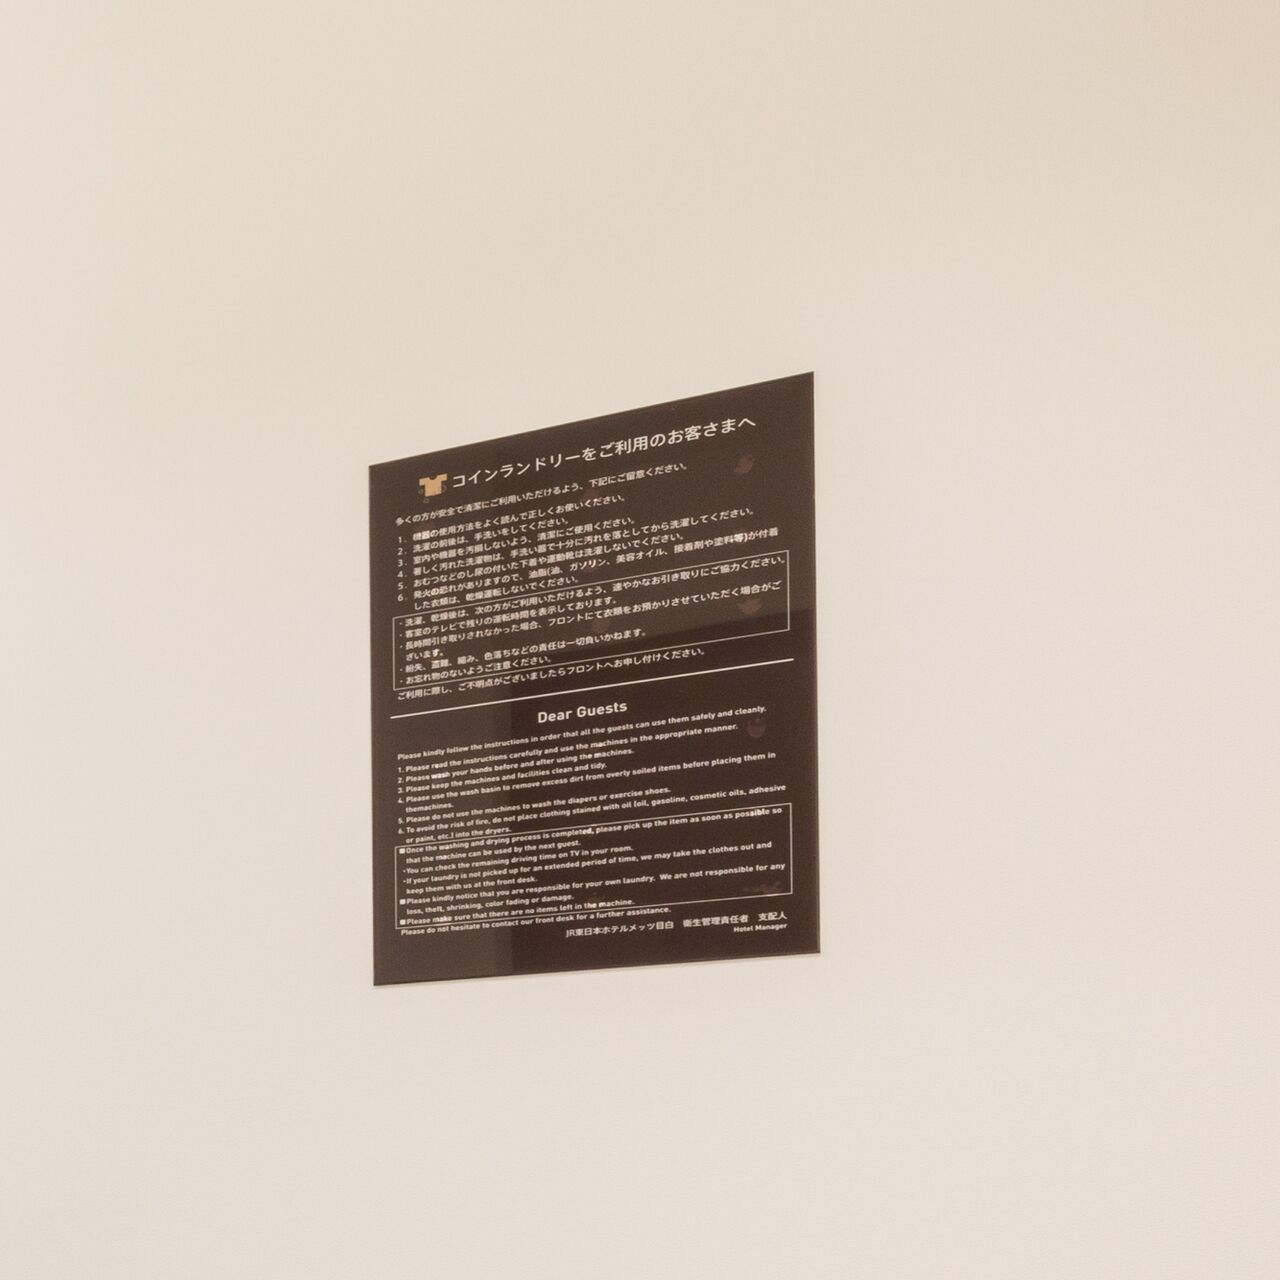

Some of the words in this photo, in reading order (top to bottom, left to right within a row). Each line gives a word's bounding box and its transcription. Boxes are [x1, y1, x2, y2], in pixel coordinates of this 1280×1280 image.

[452, 413, 756, 488] コインランドリーをご利用のお客さまへ
[537, 707, 572, 723] Dear
[576, 700, 627, 718] Guests
[397, 751, 421, 760] Please
[423, 747, 444, 758] kindly
[446, 744, 468, 753] follow
[484, 736, 528, 748] instructions
[540, 732, 560, 741] order
[563, 729, 578, 738] that
[607, 722, 633, 733] guests
[668, 714, 689, 724] them
[691, 711, 715, 722] safely
[734, 704, 766, 716] cleanly.
[733, 924, 753, 933] Hotel
[755, 921, 787, 932] Manager
